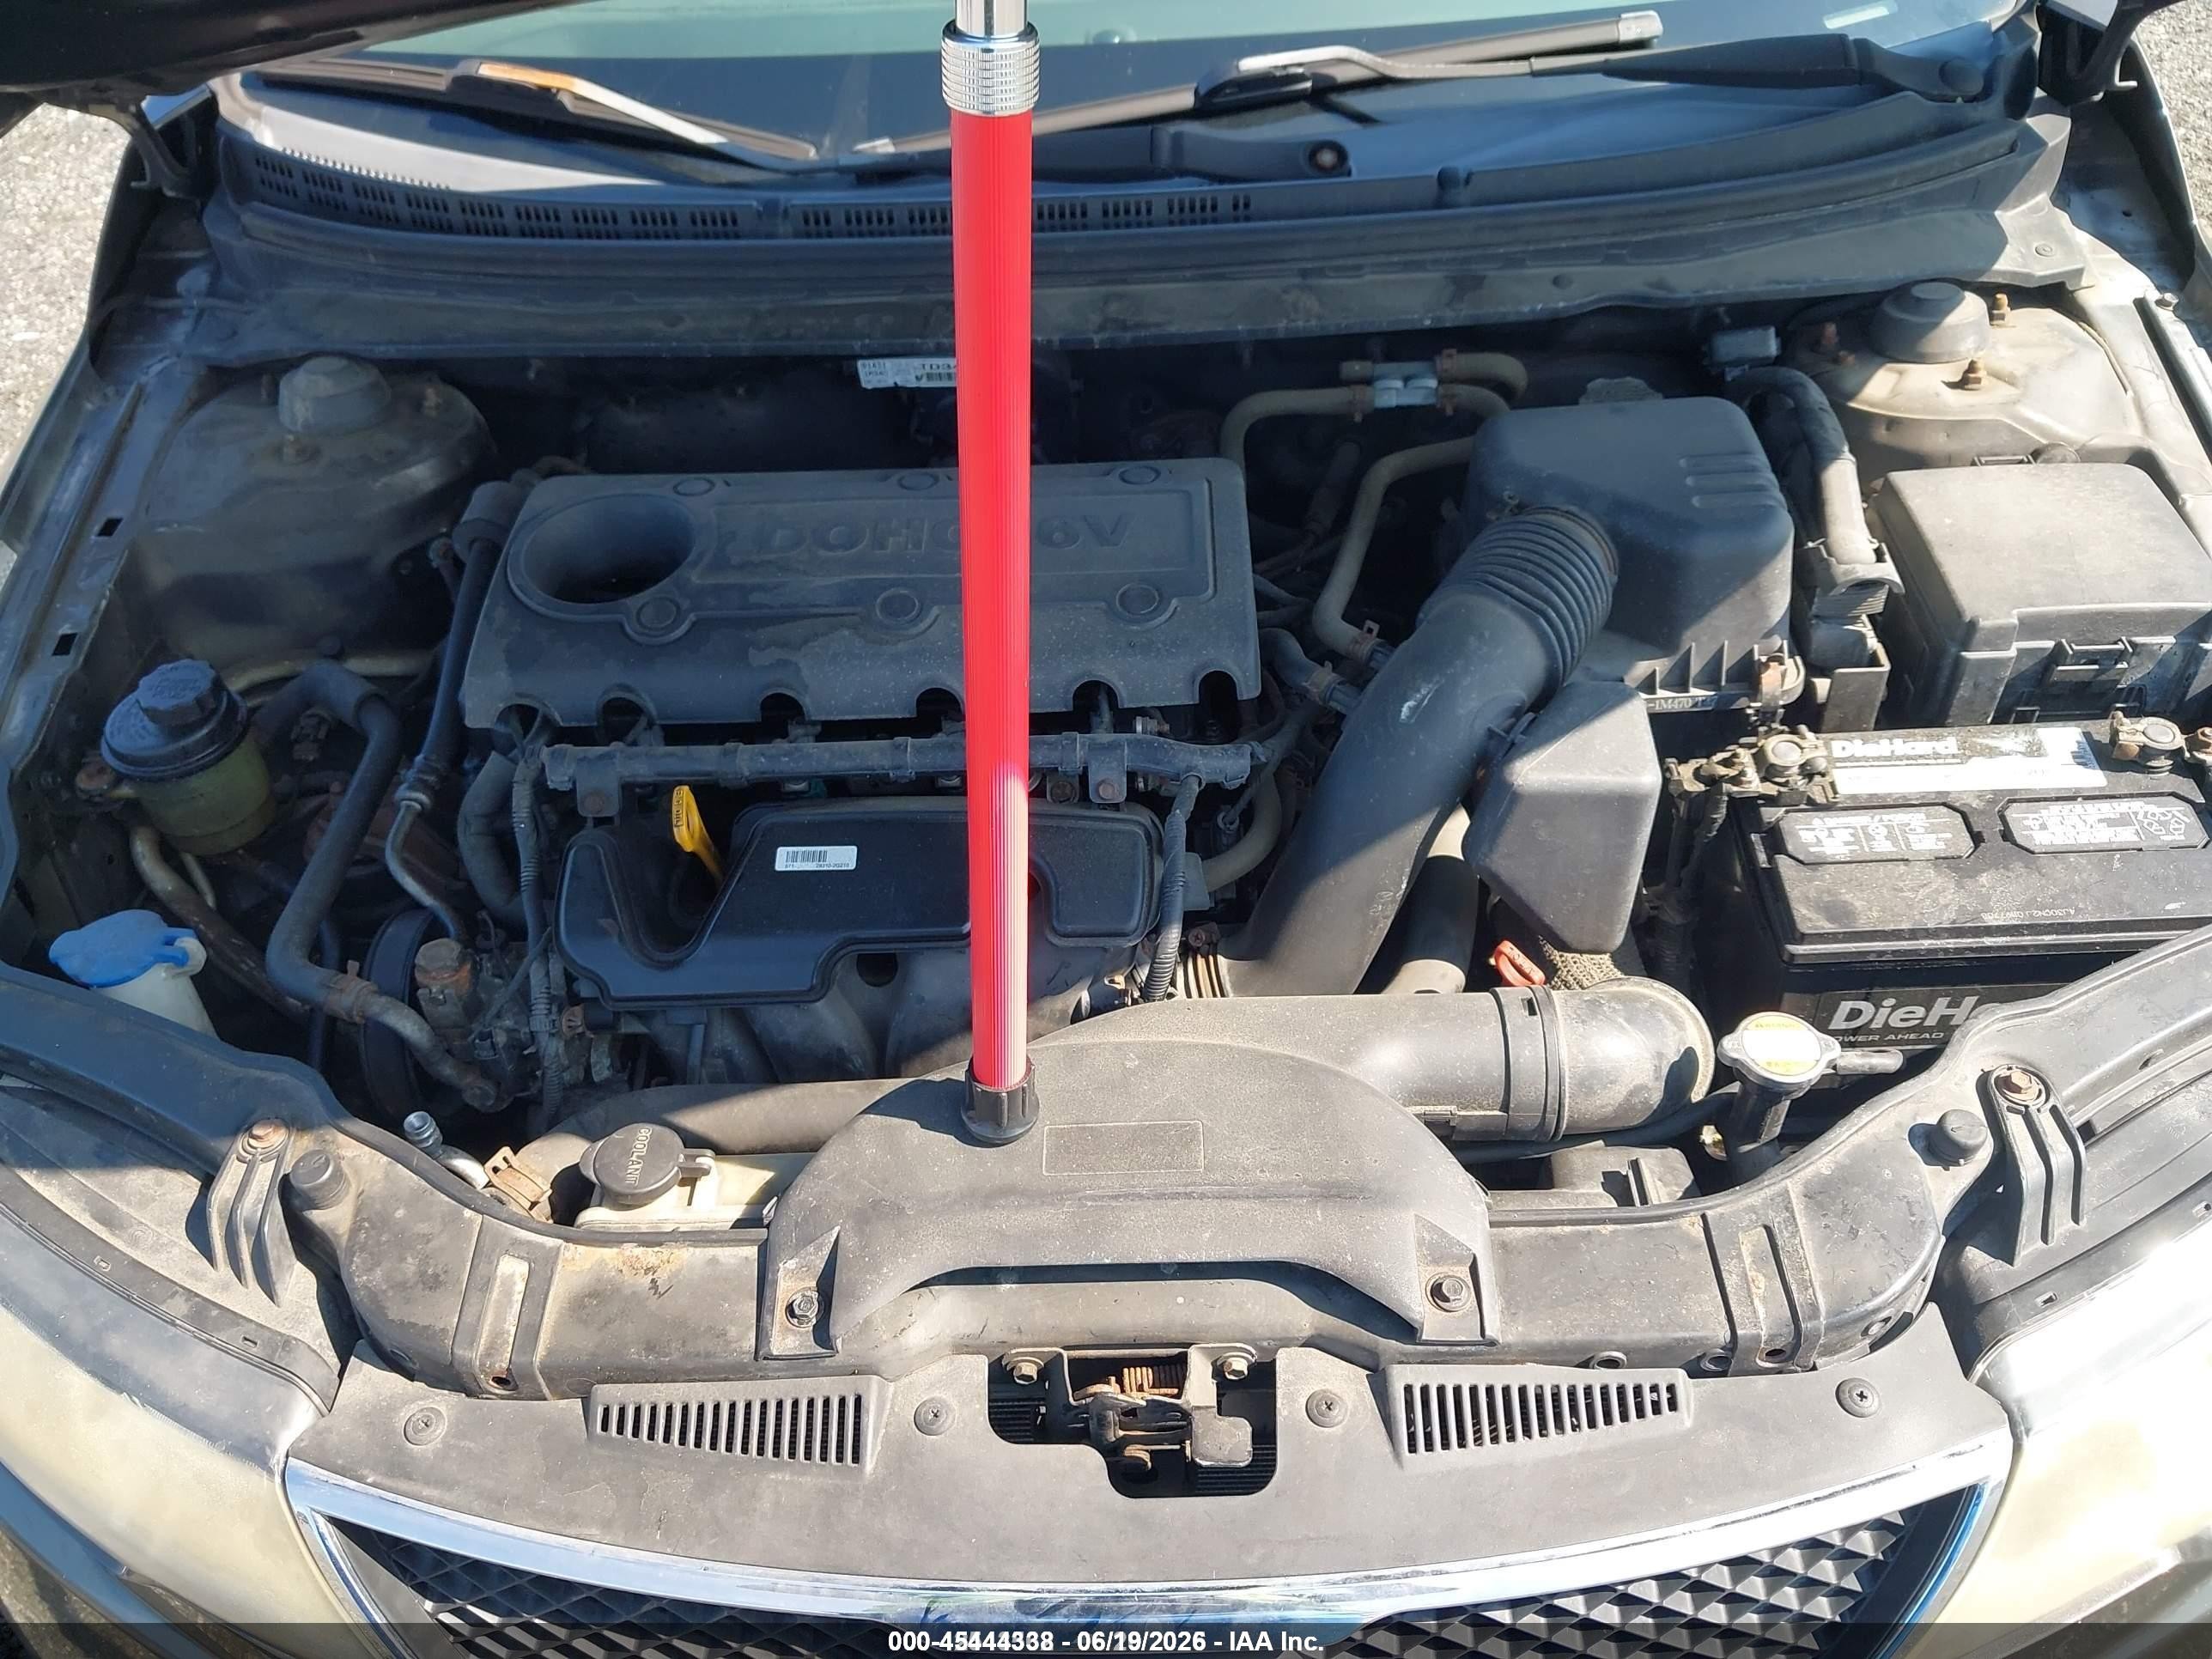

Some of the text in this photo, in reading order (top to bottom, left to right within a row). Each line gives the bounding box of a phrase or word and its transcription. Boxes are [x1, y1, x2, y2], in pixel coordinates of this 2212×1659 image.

[1031, 515, 1133, 550] 6V
[1831, 736, 1959, 758] DieHard
[1827, 995, 1980, 1030] DieH
[1883, 1032, 1945, 1041] AHEAD
[624, 1126, 653, 1187] COOLANT
